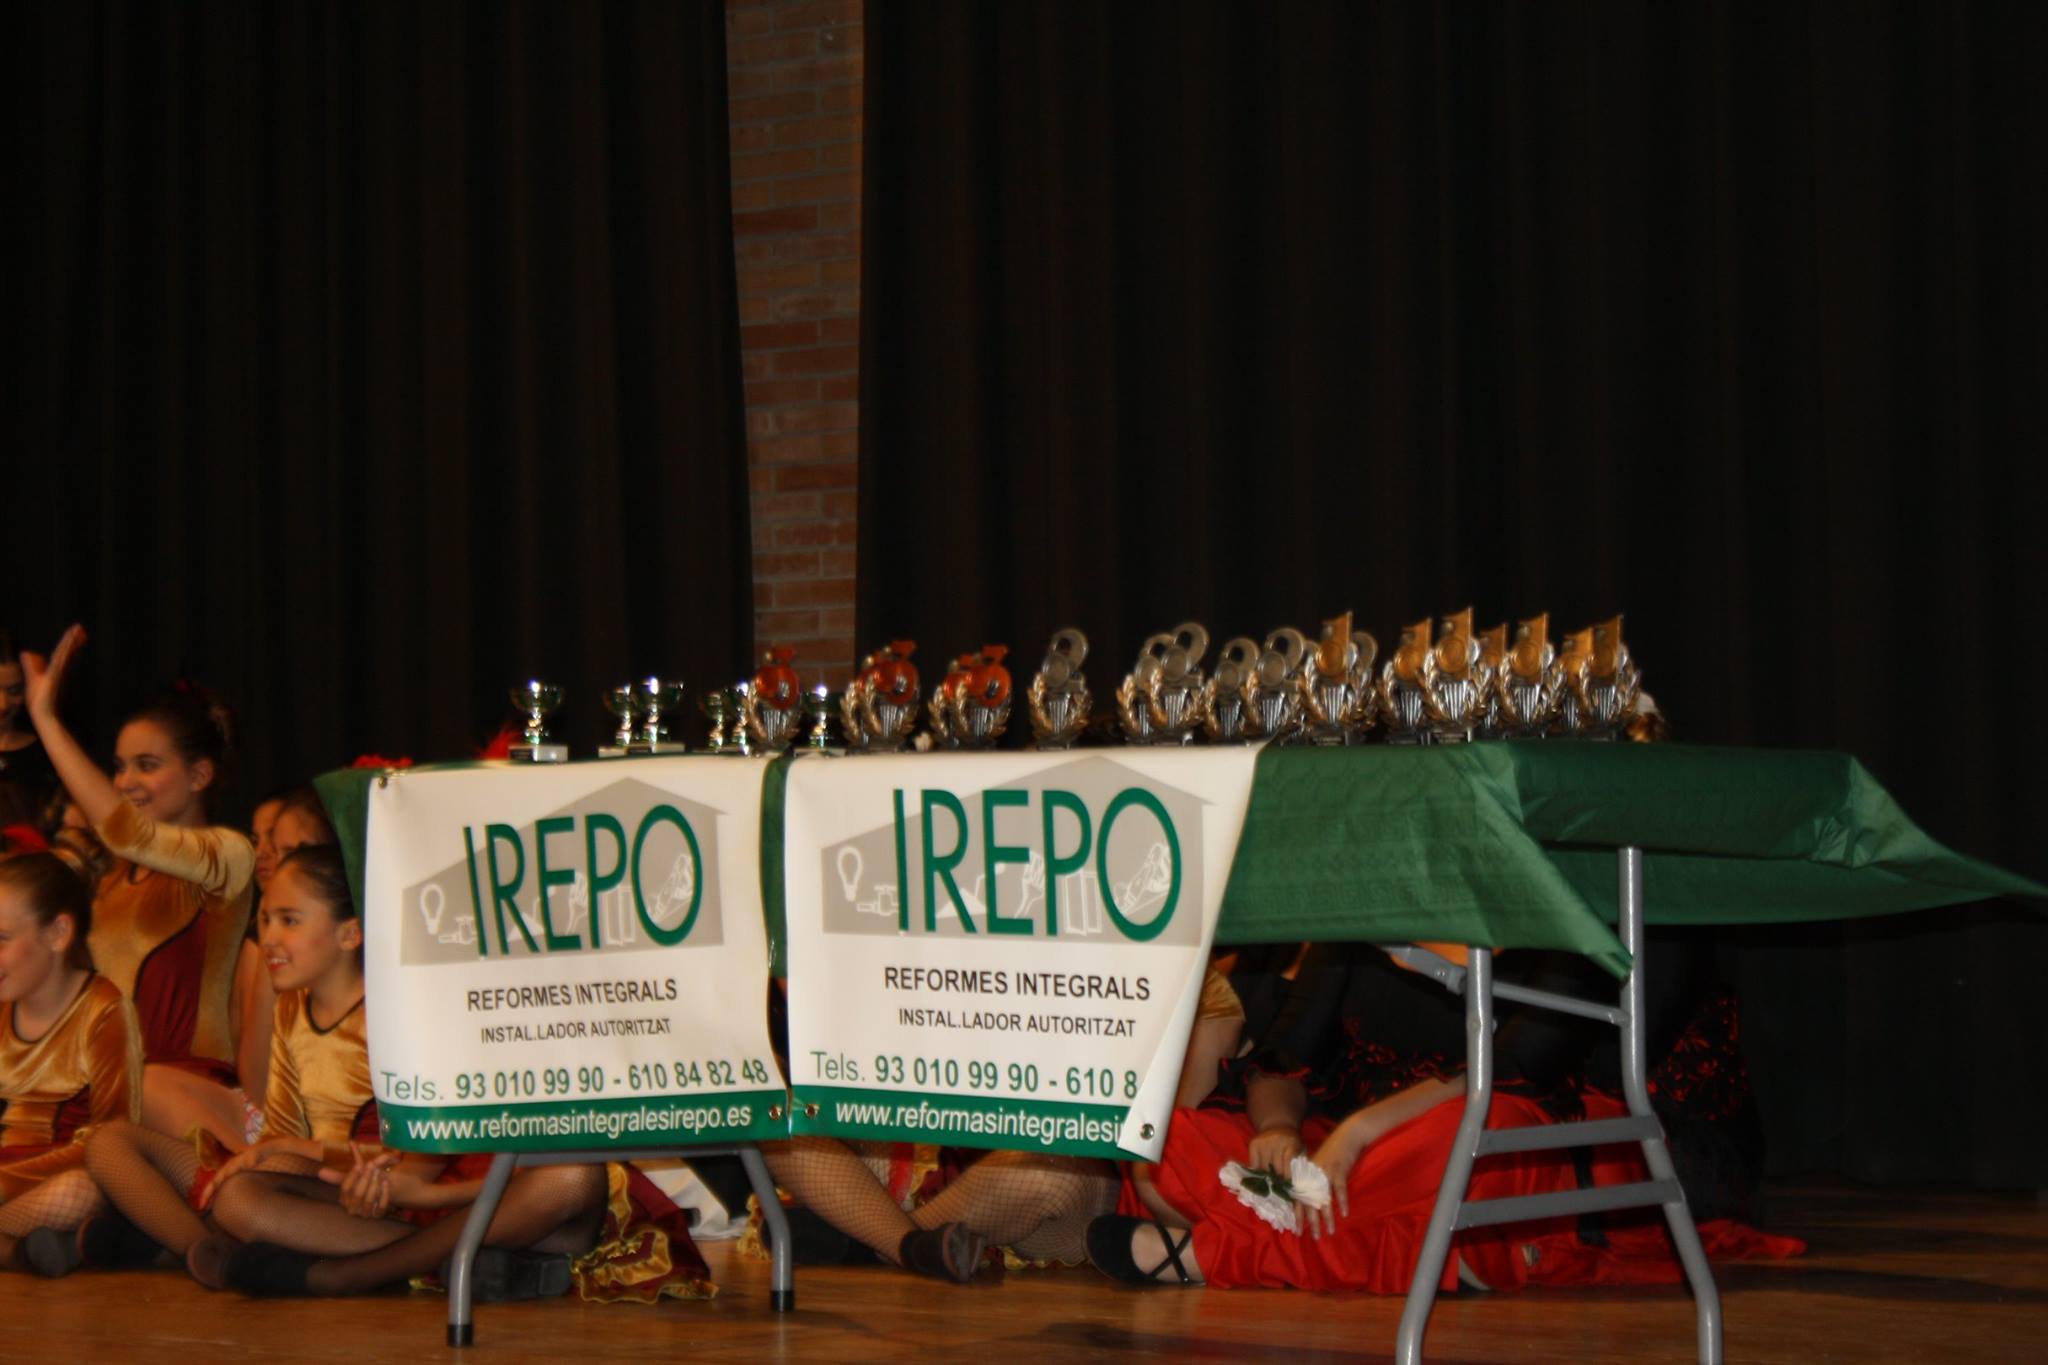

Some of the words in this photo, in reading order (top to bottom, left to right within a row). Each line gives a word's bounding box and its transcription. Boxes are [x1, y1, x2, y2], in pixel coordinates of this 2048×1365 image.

[464, 804, 703, 957] IREPO
[893, 787, 1182, 942] IREPO
[467, 984, 572, 1012] REFORMES
[574, 978, 678, 1004] INTEGRALS
[884, 966, 1008, 994] REFORMES
[1015, 972, 1151, 1001] INTEGRALS
[481, 1022, 587, 1044] INSTAL.LADOR
[589, 1018, 671, 1038] AUTORITZAT
[898, 1008, 1022, 1032] INSTAL.LADOR
[1026, 1015, 1136, 1038] AUTORITZAT
[380, 1071, 445, 1101] Tels.
[455, 1072, 487, 1099] 93
[494, 1069, 535, 1098] 010
[543, 1067, 571, 1095] 99
[578, 1066, 605, 1093] 90
[628, 1062, 668, 1091] 610
[674, 1061, 703, 1088] 84
[708, 1059, 736, 1087] 82
[740, 1058, 769, 1085] 48
[810, 1050, 866, 1083] Tels.
[874, 1055, 906, 1085] 93
[913, 1056, 960, 1088] 010
[967, 1060, 999, 1091] 99
[1008, 1062, 1040, 1093] 90
[1064, 1066, 1115, 1098] 610
[1123, 1070, 1139, 1100] 8
[407, 1104, 751, 1140] www.reformasintegralesirepo.es
[836, 1100, 1127, 1145] www.reformasintegralesi
